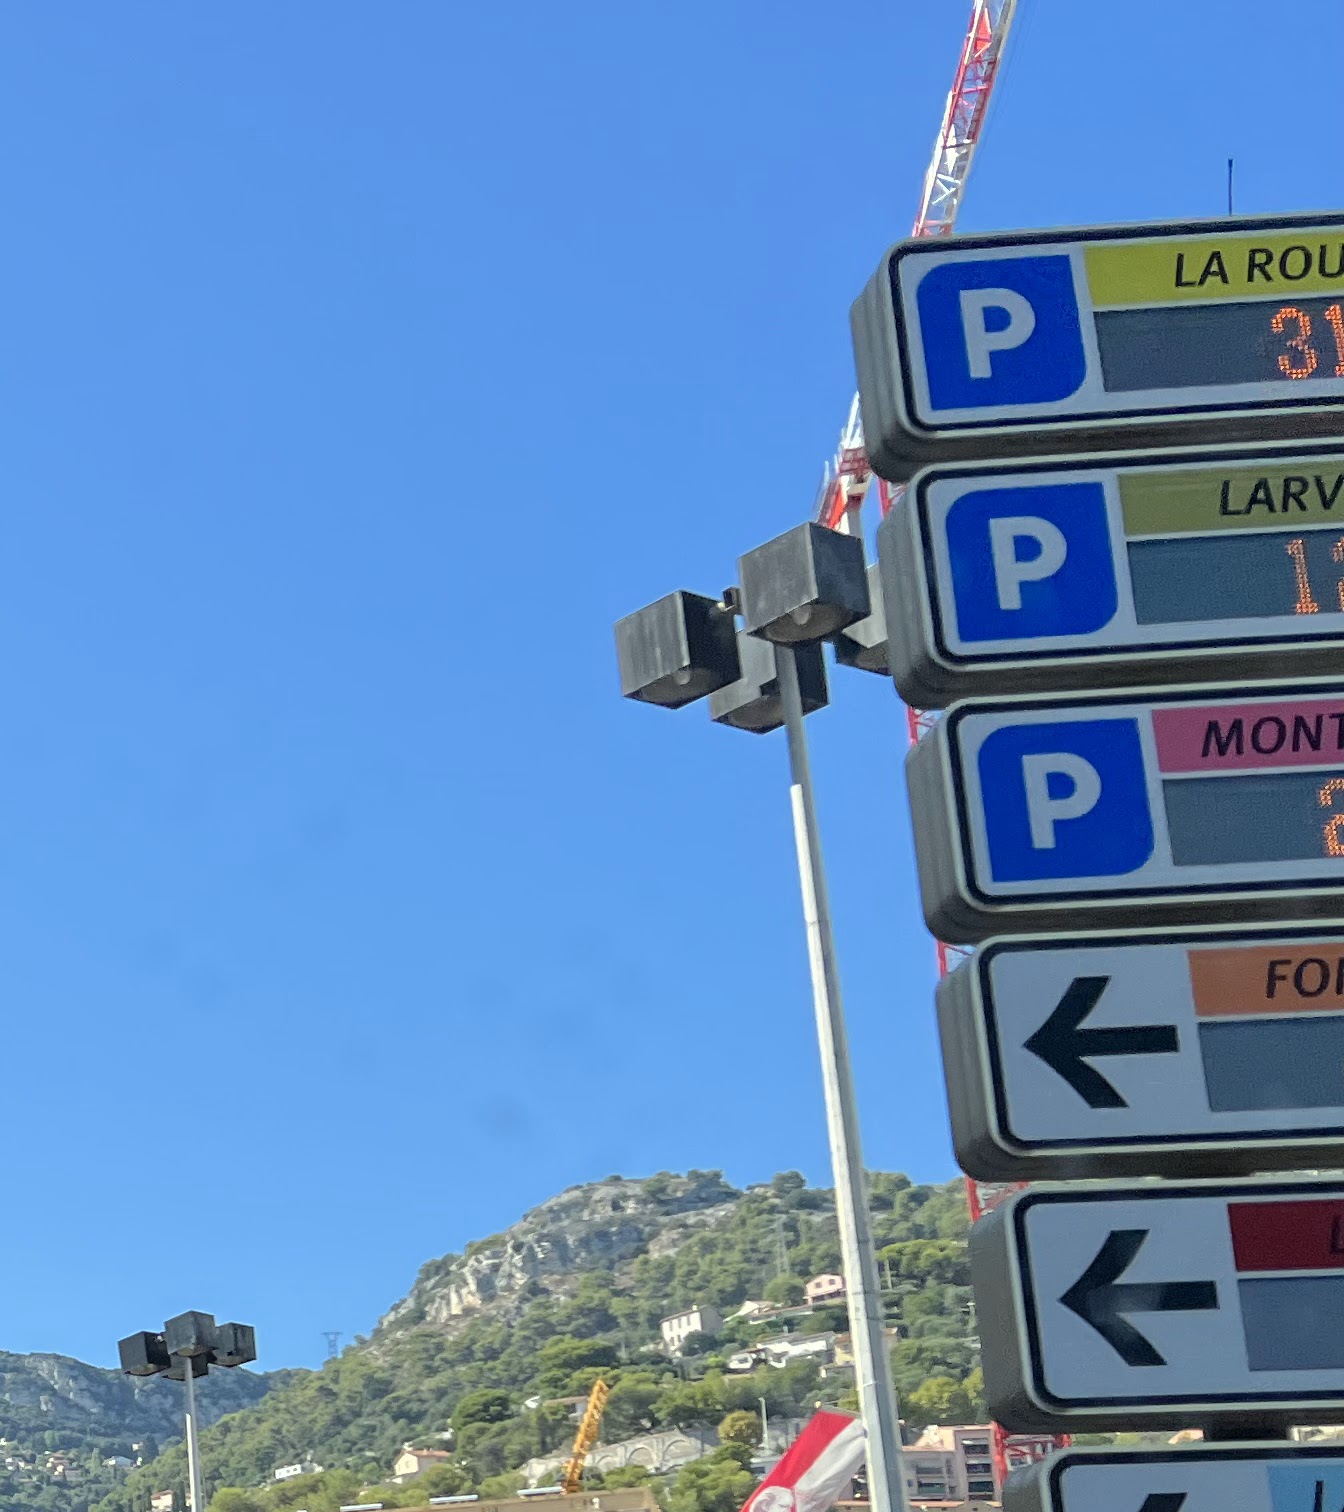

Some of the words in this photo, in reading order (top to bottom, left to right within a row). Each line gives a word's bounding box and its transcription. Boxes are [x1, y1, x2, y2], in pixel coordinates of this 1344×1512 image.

[1175, 249, 1229, 287] LA
[959, 287, 1036, 380] P
[990, 515, 1067, 610] P
[1021, 752, 1102, 849] P
[1265, 957, 1344, 999] FO
